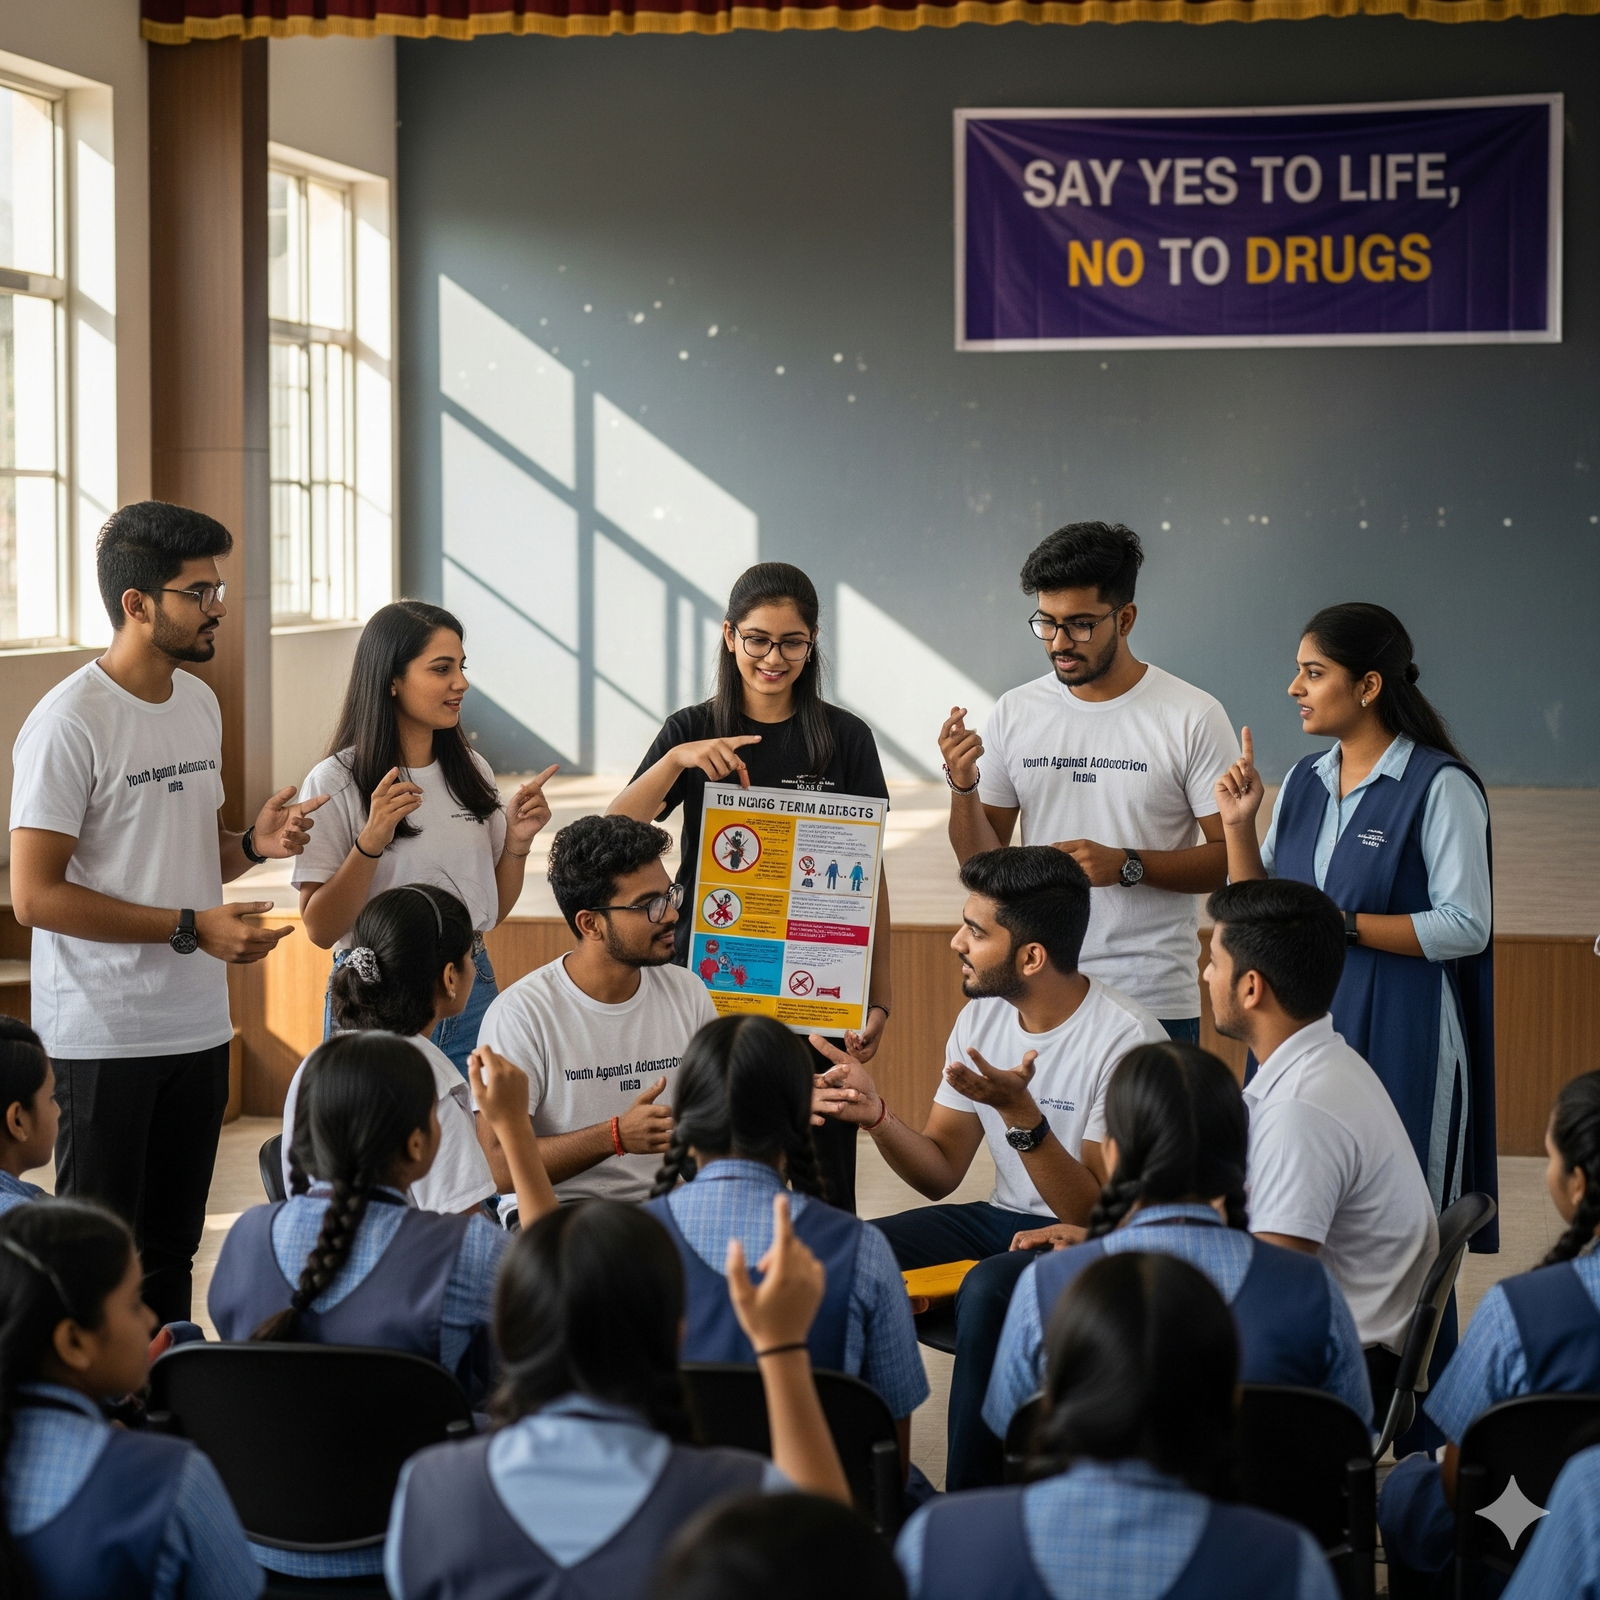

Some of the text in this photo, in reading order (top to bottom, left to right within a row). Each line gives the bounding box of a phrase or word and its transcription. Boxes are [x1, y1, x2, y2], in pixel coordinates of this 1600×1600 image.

[1023, 153, 1461, 208] SAY YES TO LIFE,
[1068, 233, 1433, 287] NO TO DRUGS
